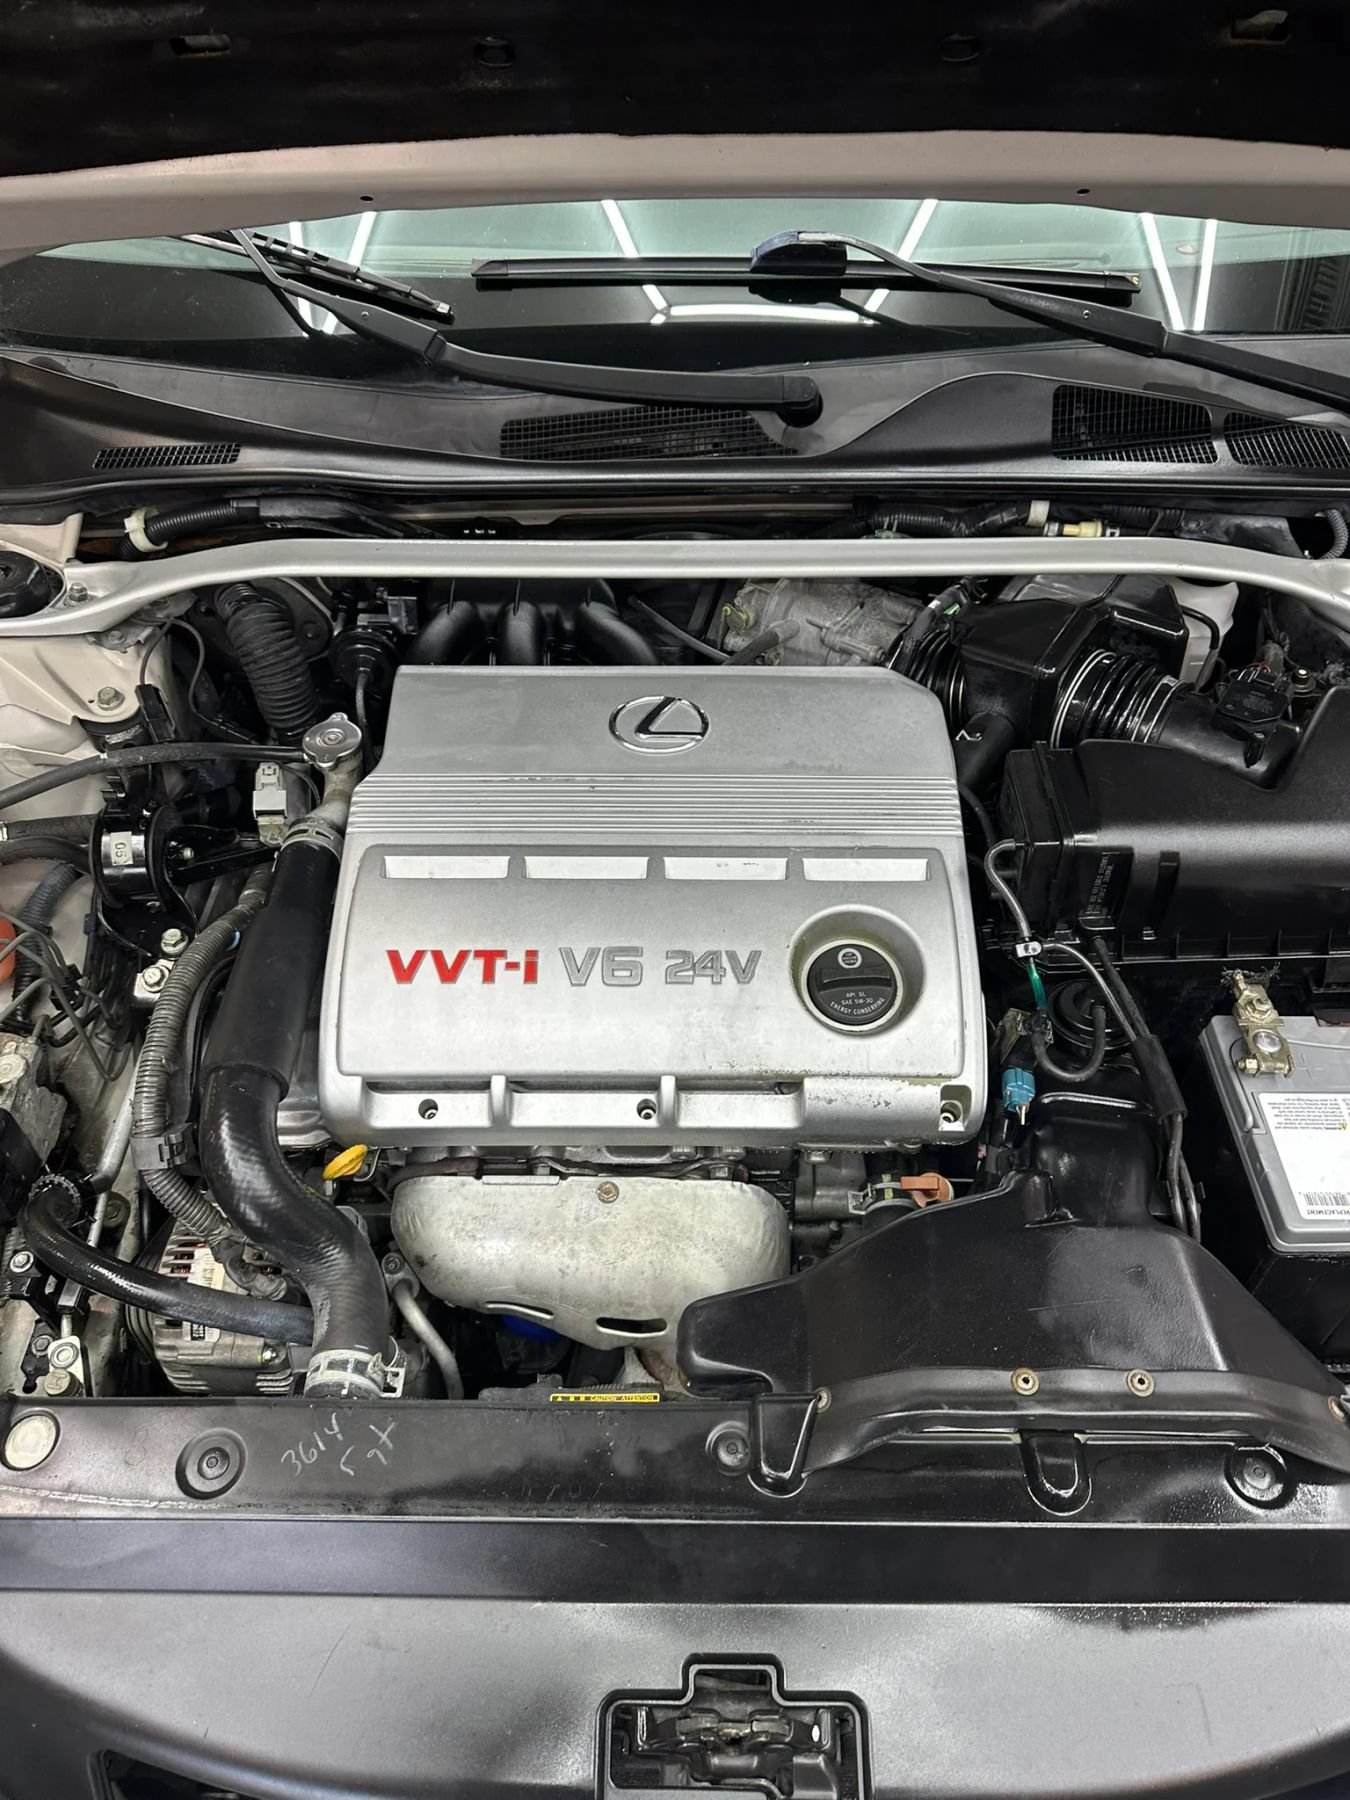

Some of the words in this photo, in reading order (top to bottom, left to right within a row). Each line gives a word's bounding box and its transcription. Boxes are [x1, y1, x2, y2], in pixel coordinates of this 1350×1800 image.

[387, 949, 539, 985] VVT-i
[558, 945, 643, 987] V6
[665, 949, 762, 985] 24V
[830, 1001, 851, 1014] ENERGY
[853, 997, 885, 1015] CONSERVING
